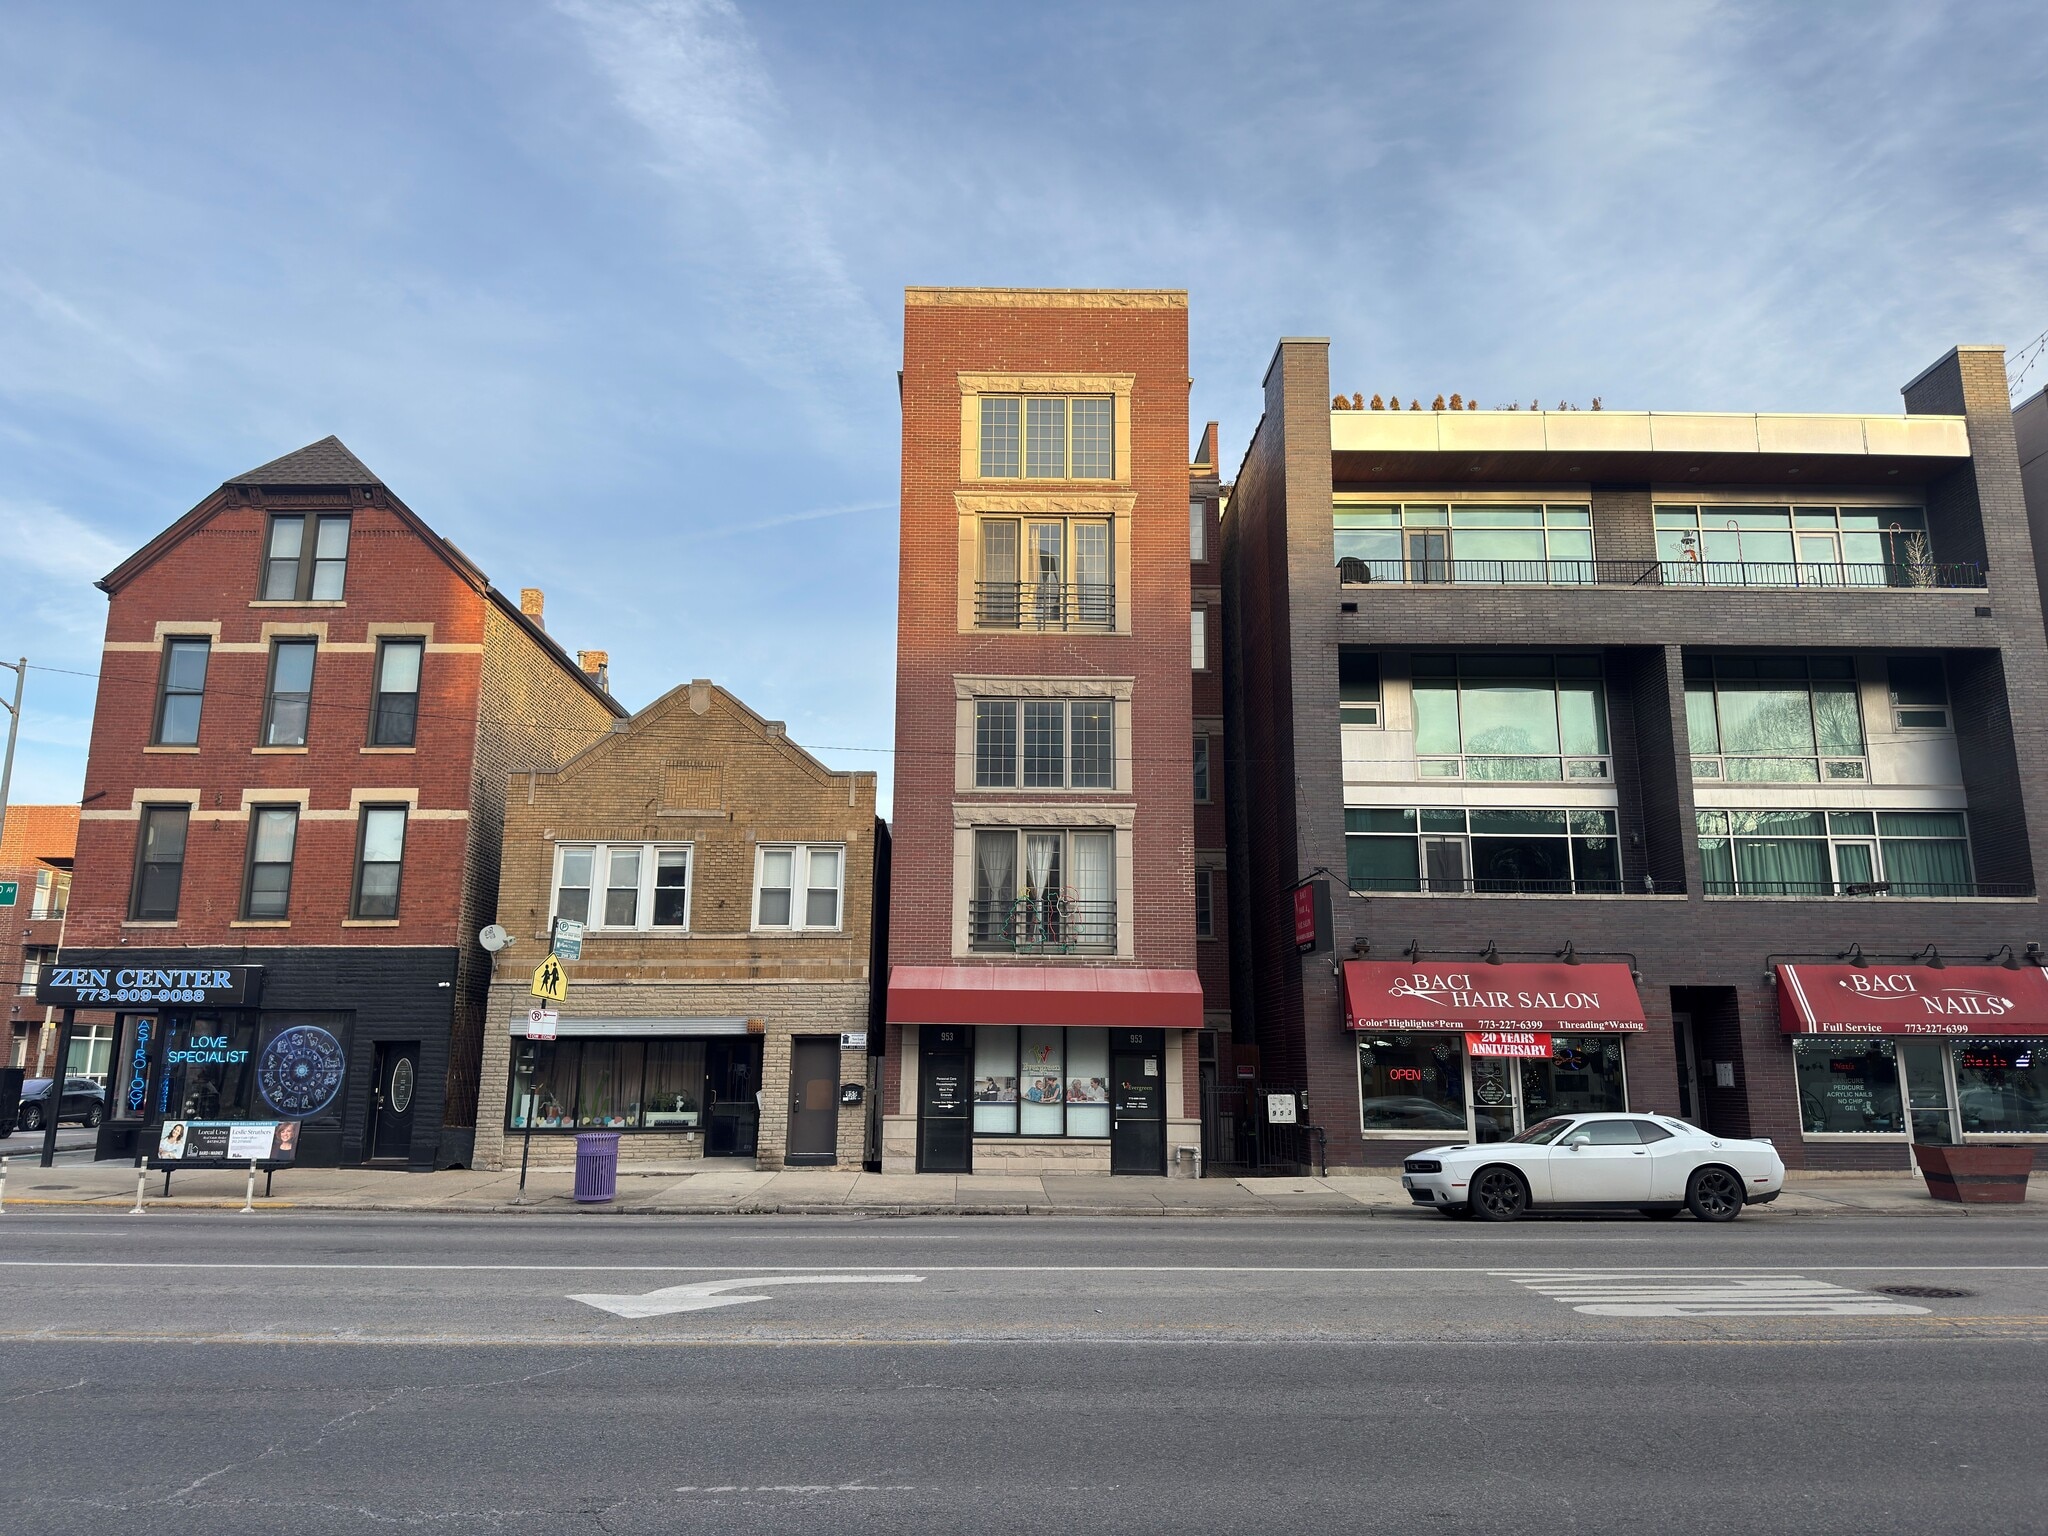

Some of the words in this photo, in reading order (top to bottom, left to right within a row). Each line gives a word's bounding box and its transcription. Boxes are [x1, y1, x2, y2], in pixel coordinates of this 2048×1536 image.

[50, 969, 111, 987] ZEN
[115, 969, 233, 988] CENTER
[1412, 974, 1472, 991] BACI
[1850, 974, 1917, 992] BACI
[76, 988, 205, 1003] 773-909-9088
[1451, 992, 1514, 1008] HAIR
[1519, 992, 1601, 1009] SALON
[1920, 996, 2005, 1015] NAILS
[1478, 1020, 1543, 1030] 773-227-6399
[1823, 1022, 1843, 1032] Full
[1845, 1023, 1882, 1033] Service
[1904, 1024, 1968, 1034] 773-227-6399
[190, 1036, 227, 1048] LOVE
[941, 1032, 954, 1041] 953
[1130, 1034, 1143, 1043] 953
[1481, 1033, 1497, 1043] 20
[1500, 1033, 1534, 1043] YEARS
[168, 1050, 248, 1063] SPECIALIST
[1471, 1043, 1546, 1057] ANNIVERSARY
[129, 1019, 150, 1111] ASTROLOGY
[1022, 1063, 1060, 1073] Evergreen
[1390, 1069, 1421, 1081] OPEN
